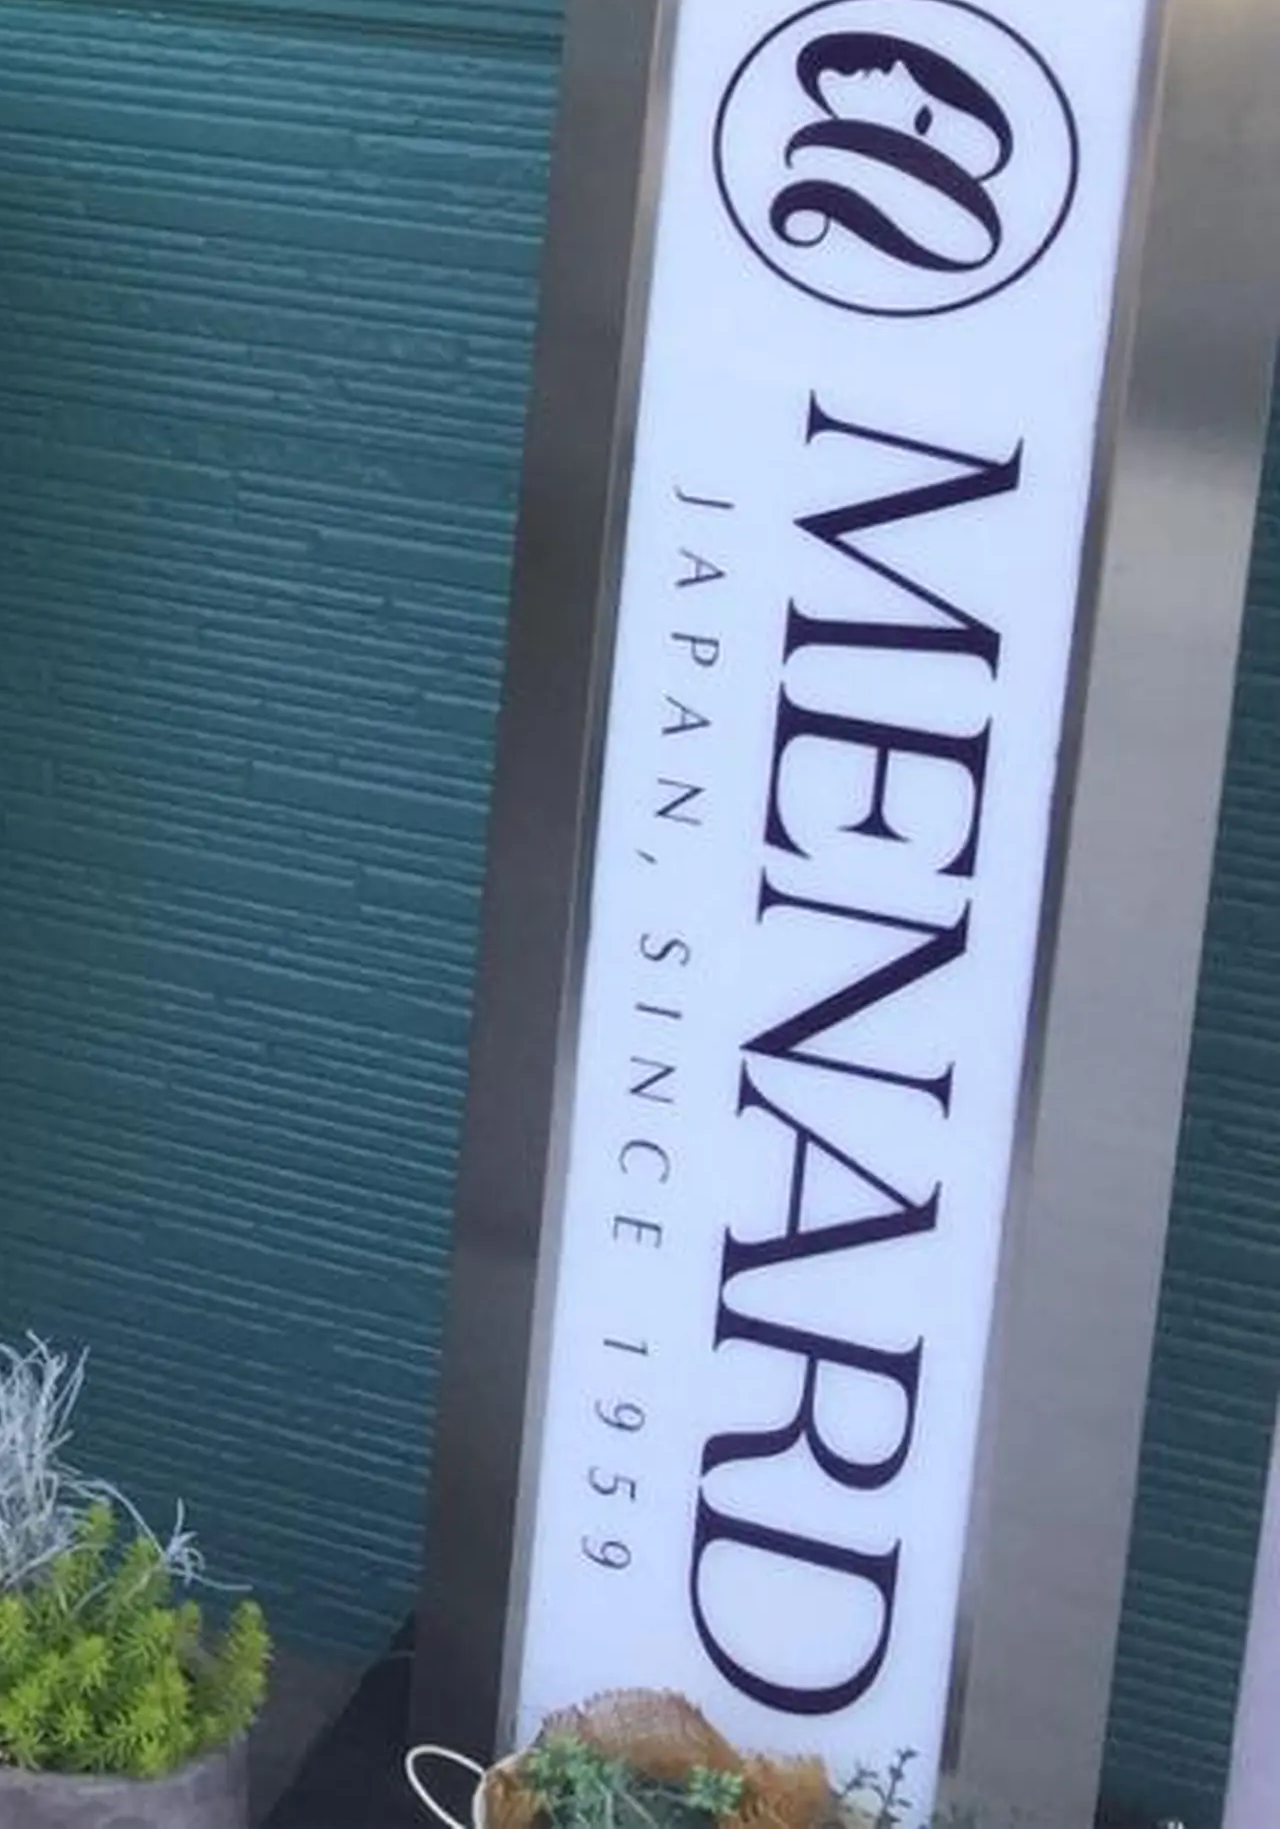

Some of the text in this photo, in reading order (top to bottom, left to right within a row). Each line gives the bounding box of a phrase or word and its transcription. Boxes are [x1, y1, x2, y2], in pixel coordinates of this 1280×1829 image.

[580, 484, 735, 1571] JAPAN, SINCE 1959
[689, 389, 1024, 1716] MENARD
